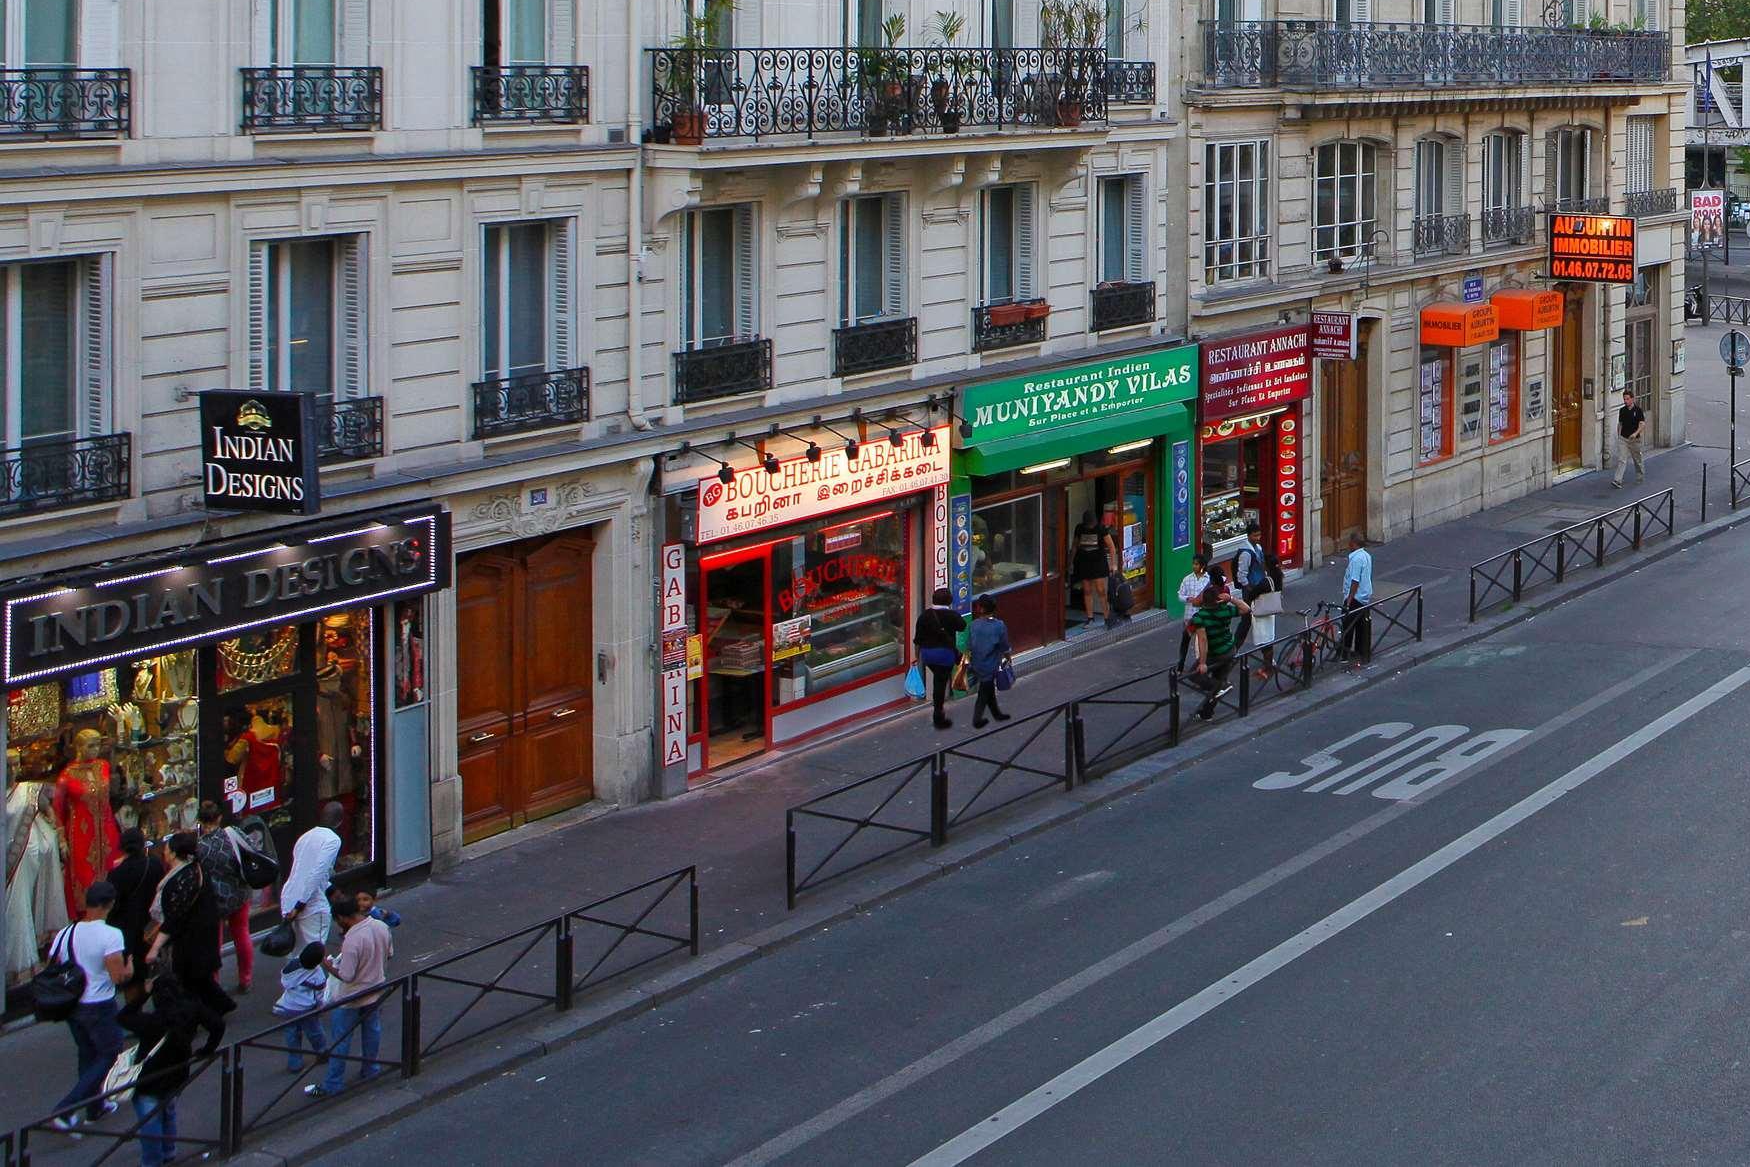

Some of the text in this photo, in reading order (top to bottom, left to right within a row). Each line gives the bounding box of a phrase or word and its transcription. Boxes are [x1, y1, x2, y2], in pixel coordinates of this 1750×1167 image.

[1693, 196, 1721, 208] BAD
[1694, 209, 1721, 218] MOMS
[1554, 238, 1633, 256] IMMOBILIER
[1553, 260, 1632, 280] 01.46.07.72.05
[1313, 314, 1349, 325] RESTAURANT
[1319, 324, 1342, 335] ANNACHI
[1208, 333, 1307, 365] RESTAURANT ANNACHI
[1024, 362, 1150, 394] Restaurant Indien
[1274, 376, 1282, 385] Sri
[973, 365, 1191, 428] MUNIYANDY VILAS
[1028, 417, 1047, 427] Sur
[1051, 410, 1077, 422] Place
[1080, 408, 1089, 416] et
[1101, 396, 1144, 411] Emporter
[1228, 399, 1238, 408] Sur
[1241, 395, 1256, 405] Place
[212, 425, 294, 463] INDIAN
[205, 462, 304, 501] DESIGNS
[725, 433, 941, 503] BOUCHERIE GABARINA
[706, 484, 720, 505] BG
[726, 493, 802, 521] கபறினா
[936, 484, 947, 588] BOUCH
[28, 537, 423, 658] INDIAN DESIGNS
[665, 548, 684, 763] GABINA
[1253, 722, 1535, 804] BUS
